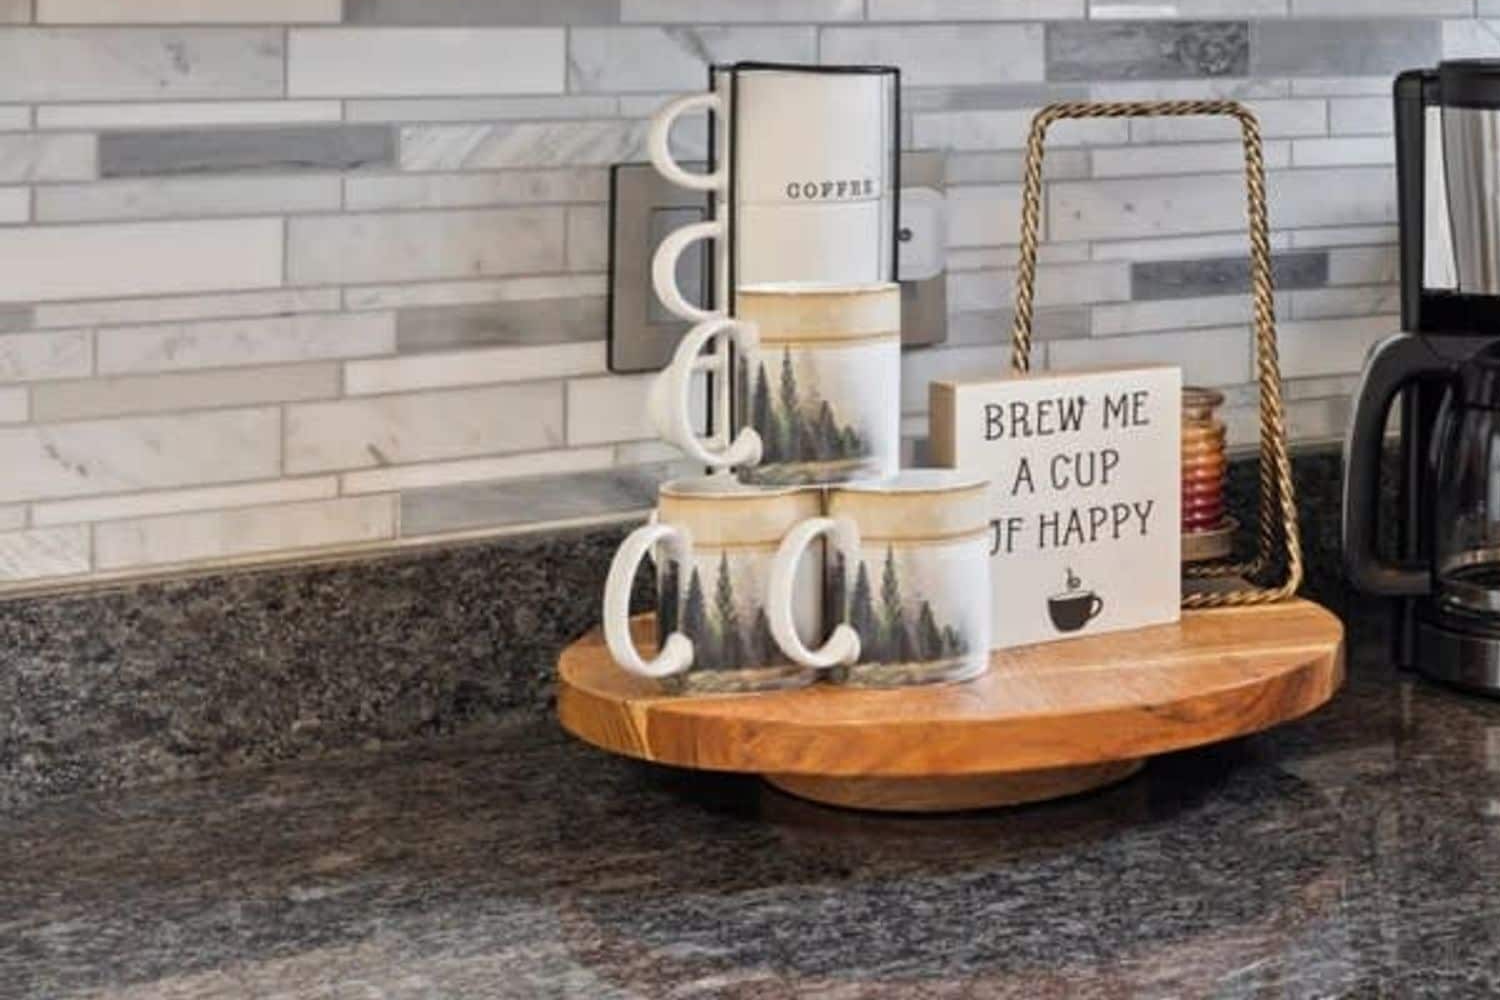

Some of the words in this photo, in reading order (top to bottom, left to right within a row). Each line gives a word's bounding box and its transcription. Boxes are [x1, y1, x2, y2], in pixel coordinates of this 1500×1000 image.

[785, 179, 873, 199] COFFEE
[984, 396, 1088, 441] BREW
[1102, 390, 1151, 428] ME
[1011, 457, 1035, 496] A
[1050, 449, 1119, 490] CUP
[1039, 500, 1155, 548] HAPPY
